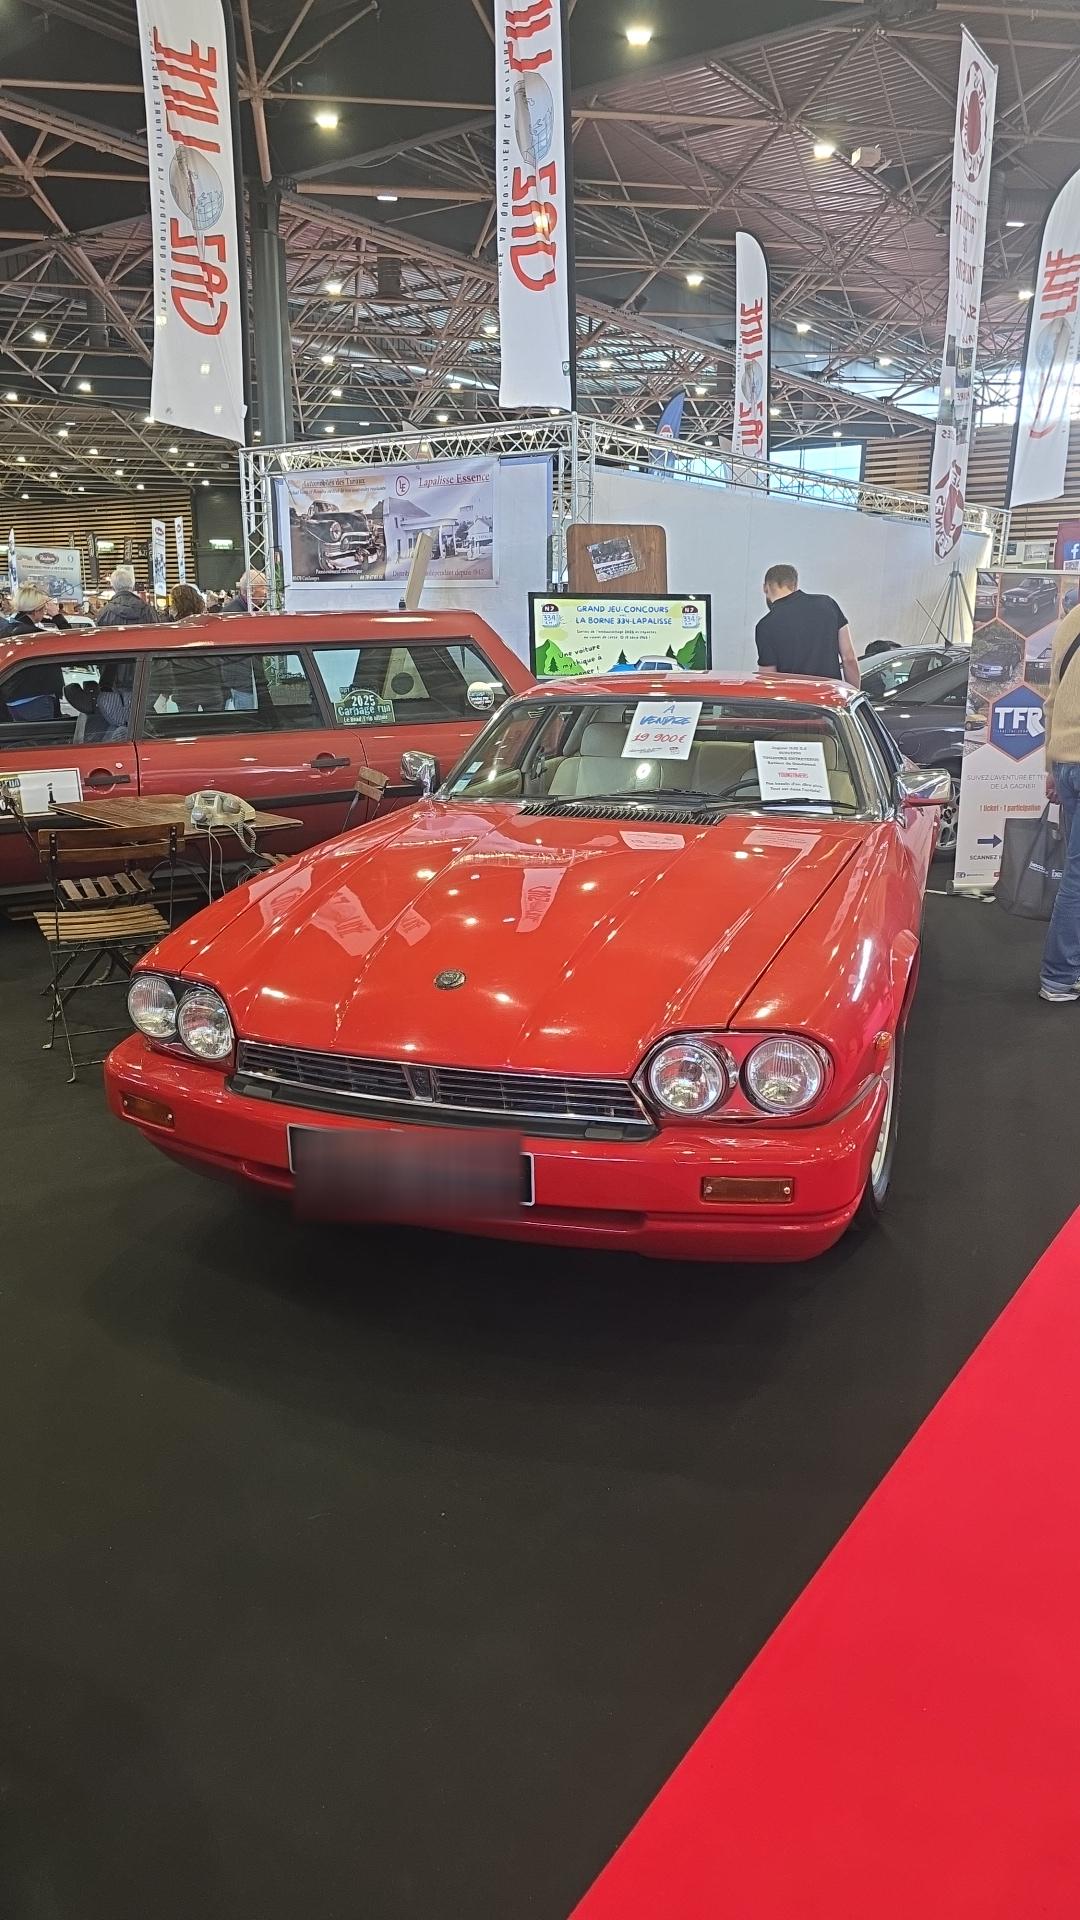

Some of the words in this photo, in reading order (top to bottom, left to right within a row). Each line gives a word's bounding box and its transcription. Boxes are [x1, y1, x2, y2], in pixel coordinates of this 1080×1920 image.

[419, 476, 454, 489] Lapalisse
[456, 473, 490, 484] Essence
[576, 605, 606, 613] GRAND
[607, 605, 669, 613] JEU-CONCOURS
[588, 617, 615, 625] BORNE
[616, 617, 673, 625] 334-LAPALISSE
[575, 645, 600, 654] voiture
[562, 657, 595, 670] mythique
[351, 694, 376, 707] 2025
[337, 705, 375, 716] Carbage
[377, 704, 391, 713] run
[639, 715, 692, 726] VENDRE
[994, 707, 1046, 737] TFR
[632, 732, 650, 742] 19
[983, 804, 999, 812] ticket
[1007, 804, 1041, 813] participation
